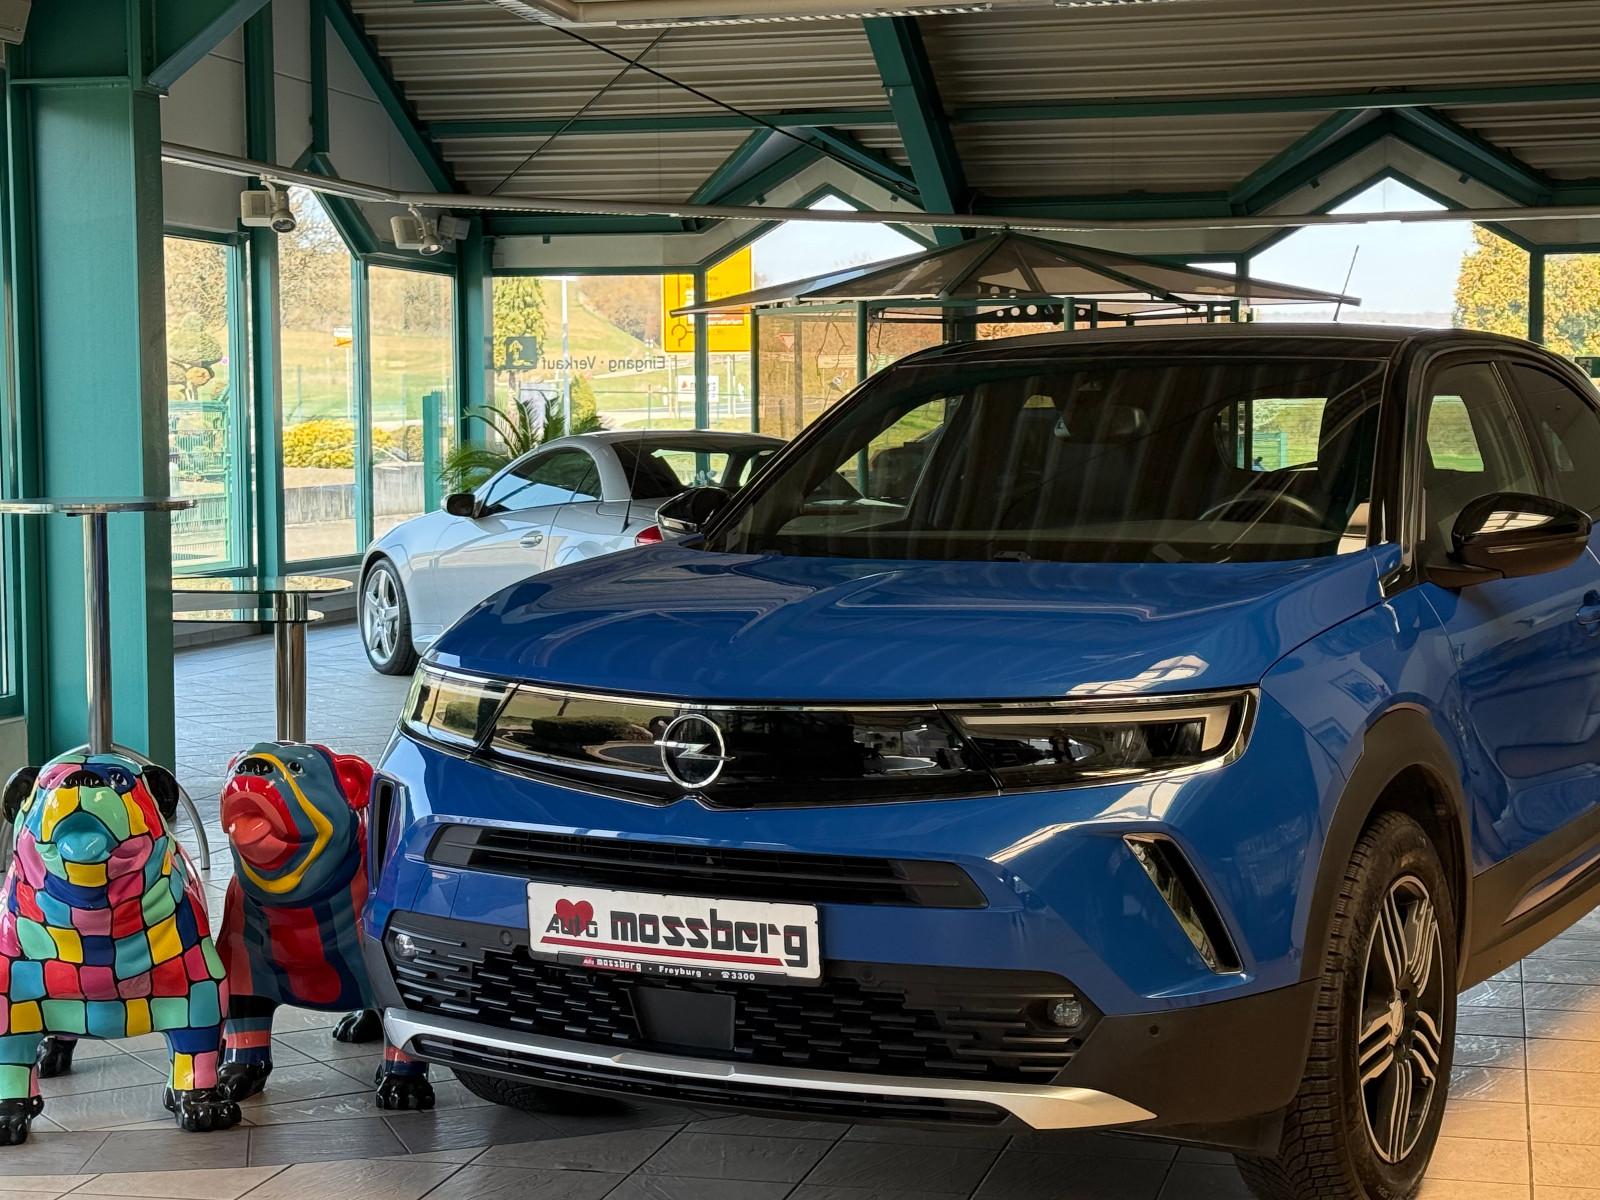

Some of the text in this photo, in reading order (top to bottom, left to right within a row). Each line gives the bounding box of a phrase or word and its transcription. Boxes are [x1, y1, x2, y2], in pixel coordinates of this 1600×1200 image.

[609, 908, 809, 968] mossberg
[659, 965, 702, 978] Freyburg
[731, 971, 756, 981] 3300
